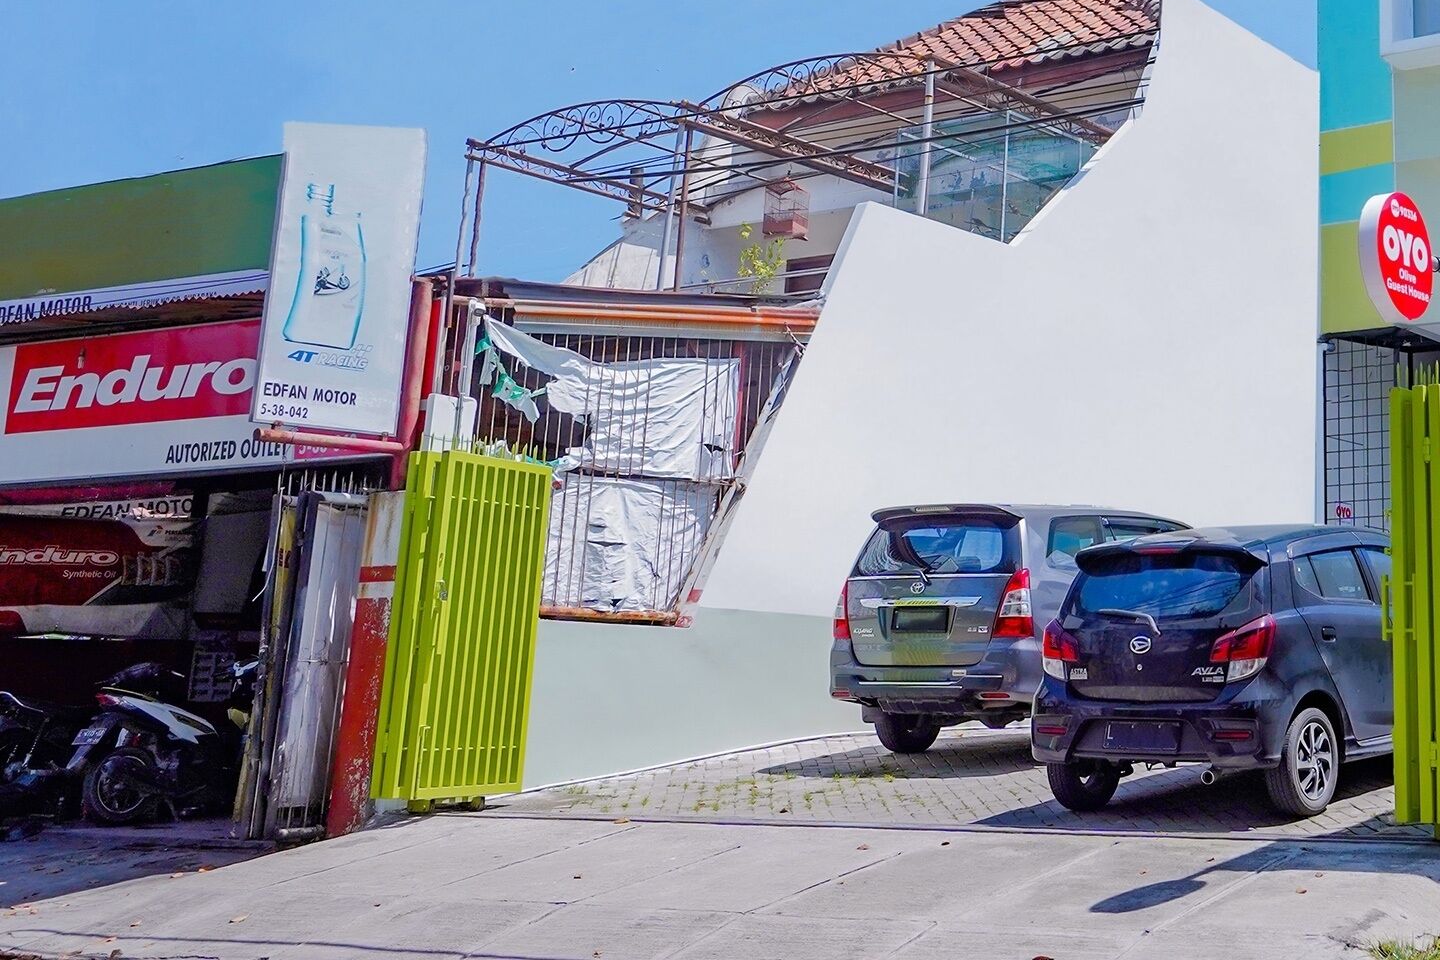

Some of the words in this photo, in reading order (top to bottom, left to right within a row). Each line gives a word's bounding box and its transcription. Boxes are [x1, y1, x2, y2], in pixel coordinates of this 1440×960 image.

[1382, 224, 1429, 273] OYO
[1399, 268, 1417, 284] Olive
[1387, 277, 1408, 295] Guest
[1408, 284, 1430, 303] House
[40, 295, 92, 317] MOTOR
[318, 352, 369, 370] RACING
[13, 354, 258, 414] Enduro
[263, 381, 308, 400] EDFAN
[312, 388, 357, 406] MOTOR
[260, 403, 309, 419] 5-38-042
[165, 444, 236, 464] AUTORIZED
[1335, 505, 1352, 519] OYO
[0, 545, 119, 566] nduro
[62, 569, 102, 580] Synthetic
[104, 570, 116, 579] Oil
[1191, 666, 1225, 676] AYLA
